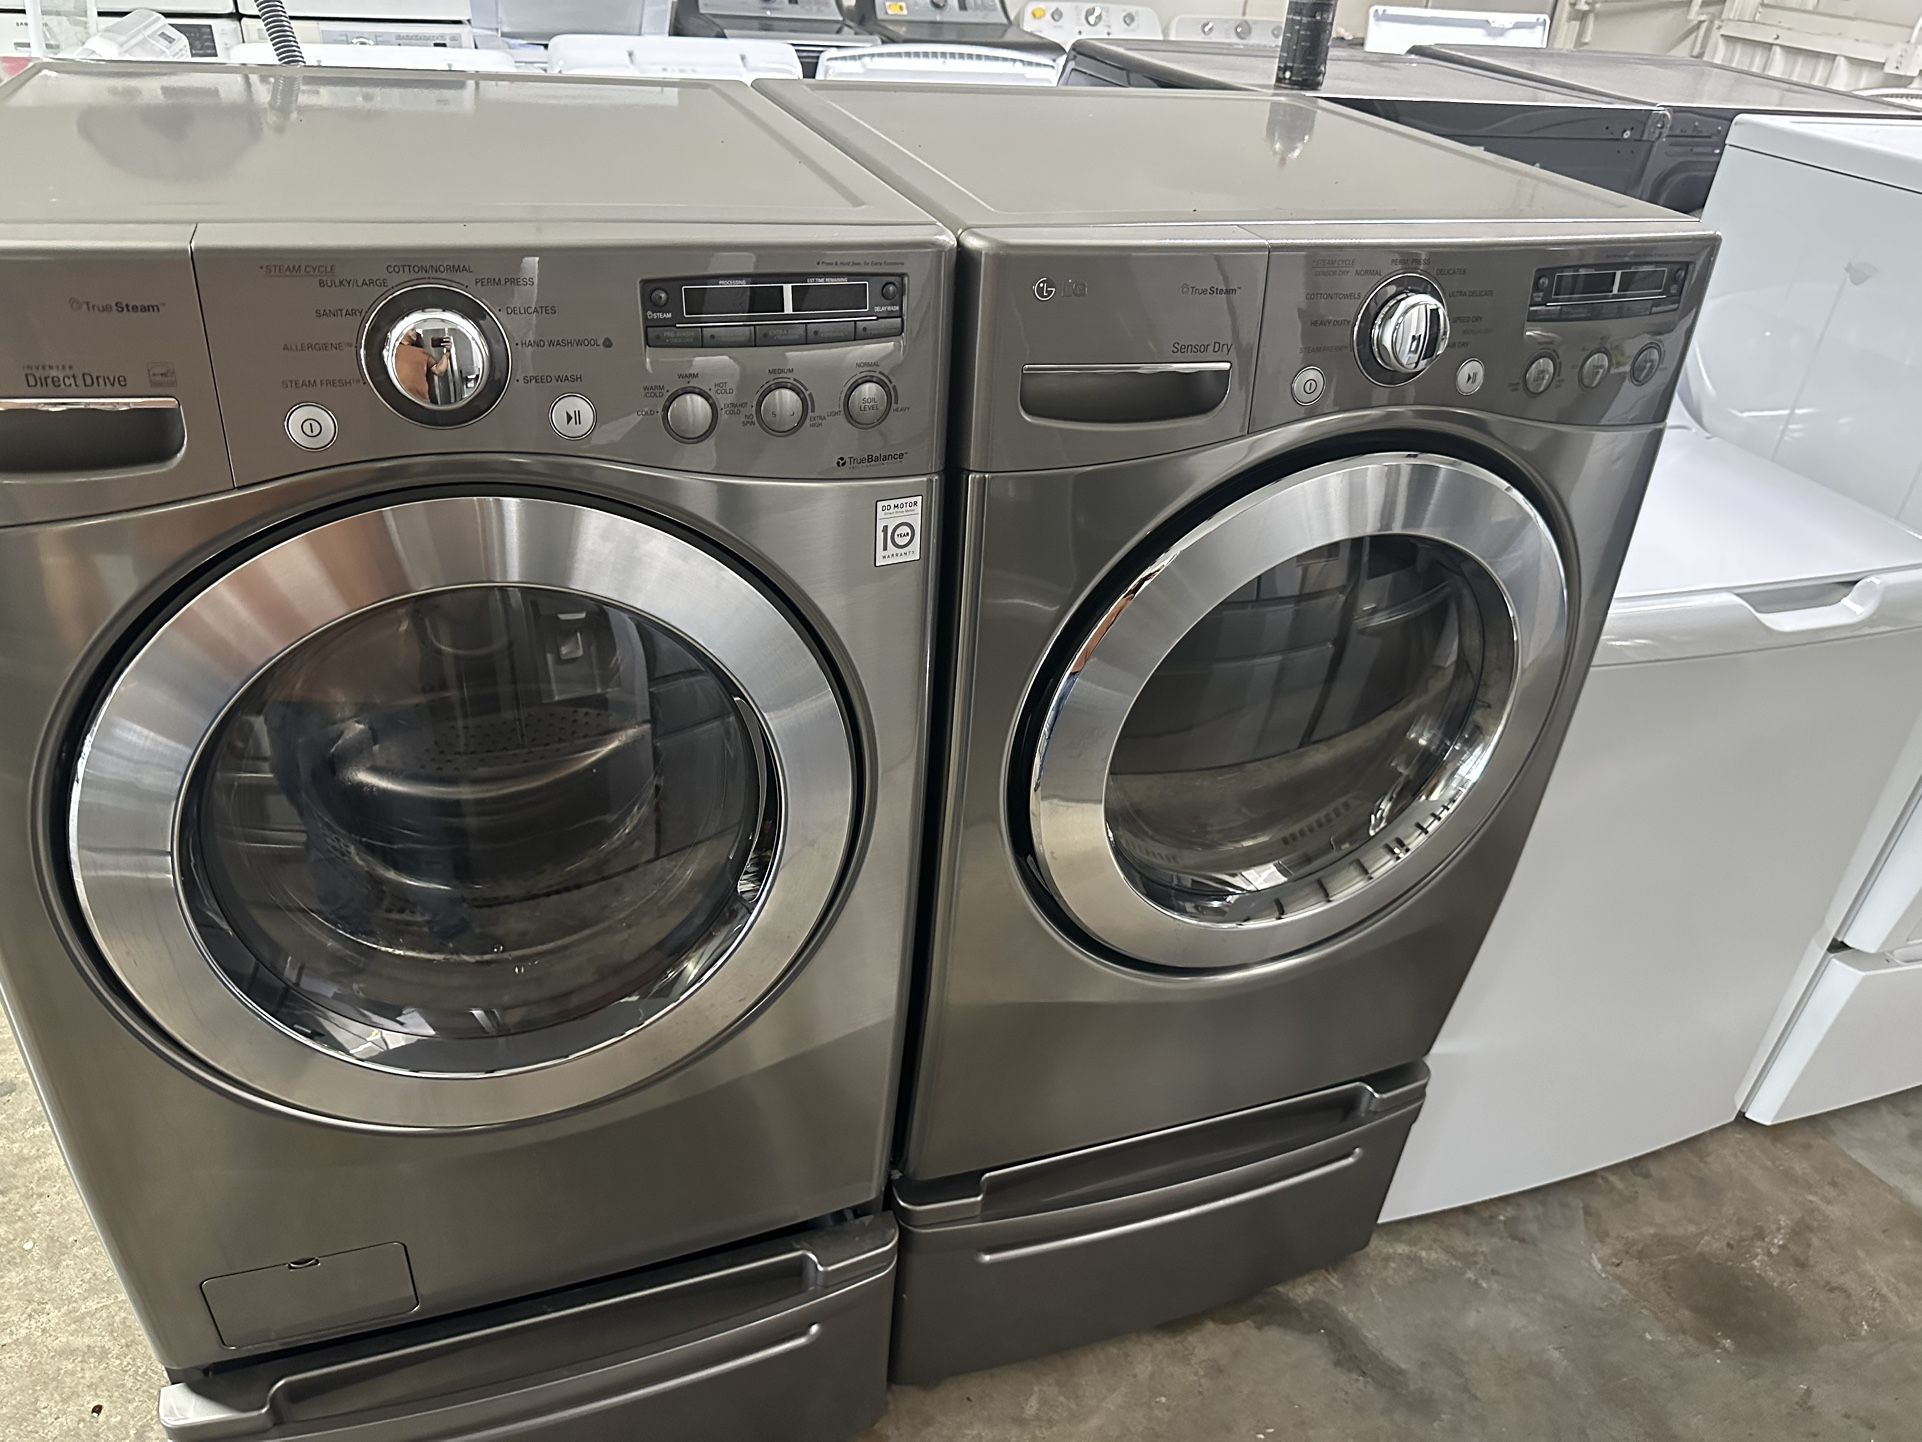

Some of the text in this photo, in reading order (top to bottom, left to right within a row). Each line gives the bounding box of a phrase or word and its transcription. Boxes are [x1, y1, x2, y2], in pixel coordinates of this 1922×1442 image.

[265, 264, 336, 274] STEAM CYCLE
[386, 264, 474, 274] COTTON/NORMAL
[318, 278, 388, 288] BULKY/LARGE
[315, 308, 364, 318] SANITARY
[506, 306, 557, 315] DELICATES
[520, 338, 600, 348] HAND WASH/WOOL
[1172, 341, 1232, 356] Sensor Dry
[25, 372, 128, 388] Direct Drive
[523, 374, 582, 384] SPEED WASH
[282, 380, 317, 389] STEAM
[894, 500, 918, 510] MOTOR
[882, 522, 916, 552] 10
[882, 550, 915, 560] WARRANTY
